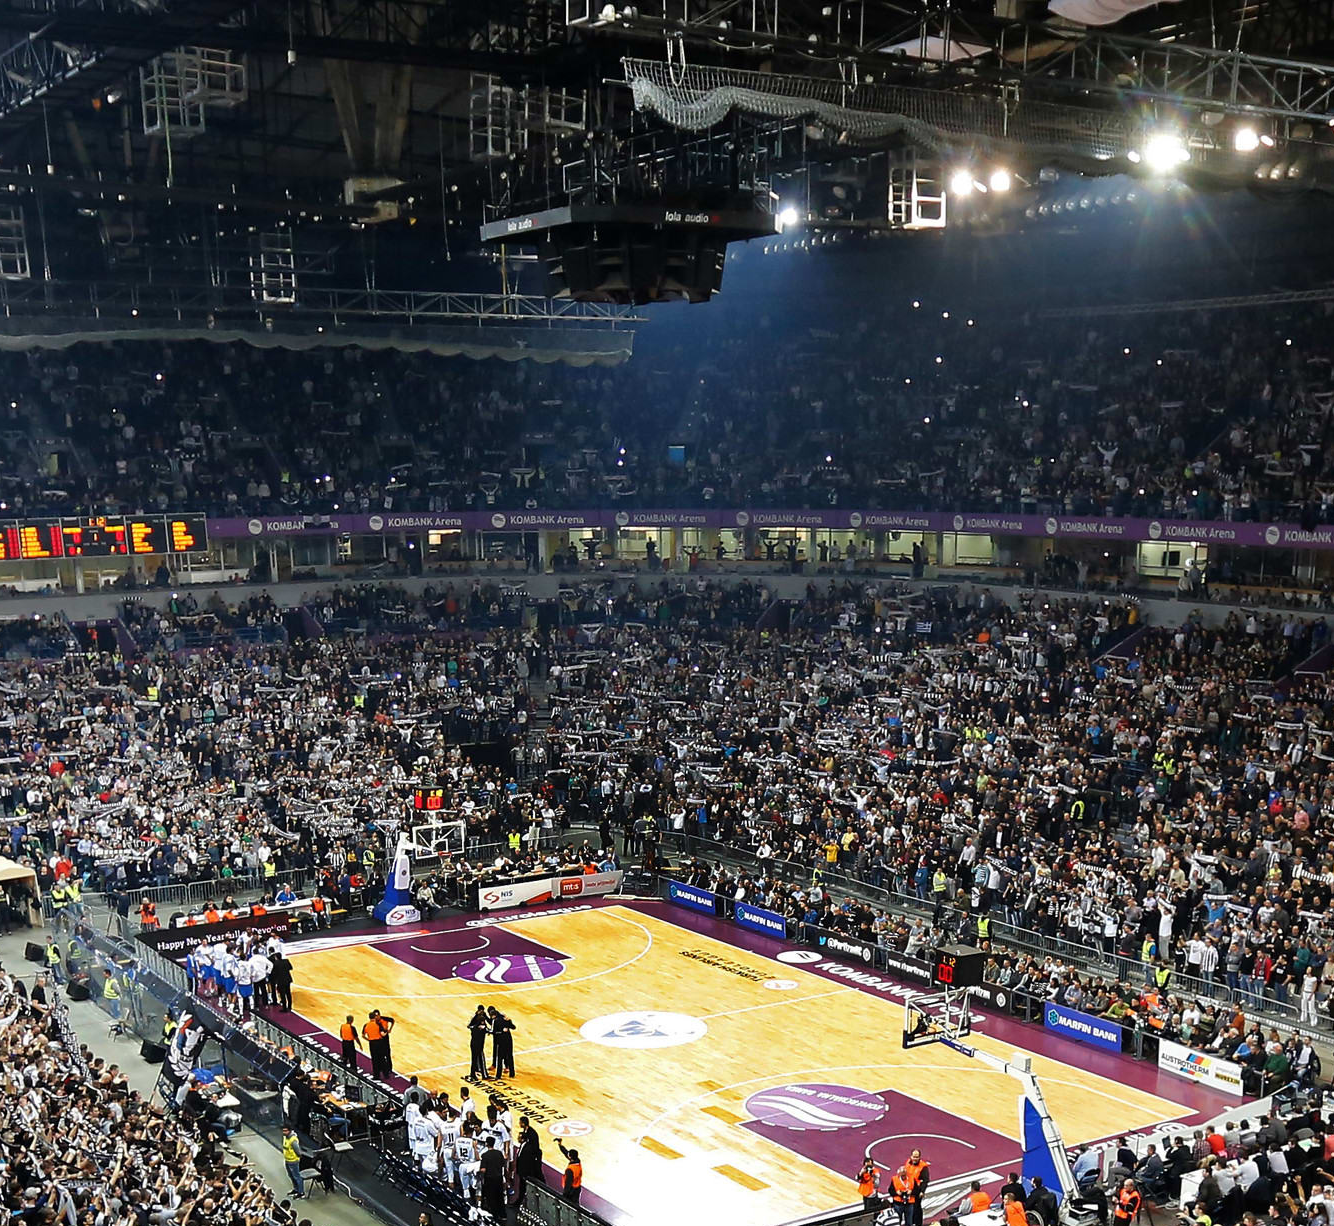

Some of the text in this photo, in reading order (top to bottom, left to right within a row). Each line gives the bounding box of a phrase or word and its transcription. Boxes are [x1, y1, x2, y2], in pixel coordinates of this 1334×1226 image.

[665, 211, 710, 223] lola audio
[388, 517, 462, 527] KOMBANK Arena
[510, 515, 584, 524] KOMBANK Arena
[633, 514, 706, 524] KOMBANK Arena
[753, 514, 822, 524] KOMBANK Arena
[865, 515, 929, 527] KOMBANK Arena
[967, 518, 1022, 530] KOMBANK Arena
[267, 521, 305, 531] KOMBAN
[1061, 522, 1123, 534] KOMBANK Arena
[1166, 526, 1236, 539] KOMBANK Arena
[1284, 530, 1332, 543] KOMBANK
[500, 889, 513, 898] NIS
[677, 890, 713, 907] MARFIN BANK
[465, 904, 593, 927] @Euroleague
[744, 912, 782, 932] MARFIN BANK
[157, 937, 185, 952] Happy
[939, 963, 953, 983] 00
[814, 962, 926, 1000] KOMBANK
[1059, 1015, 1117, 1043] MARFIN BANK
[1161, 1053, 1210, 1076] AUSTROTHERM
[448, 1133, 454, 1143] 11
[459, 1148, 468, 1157] 12
